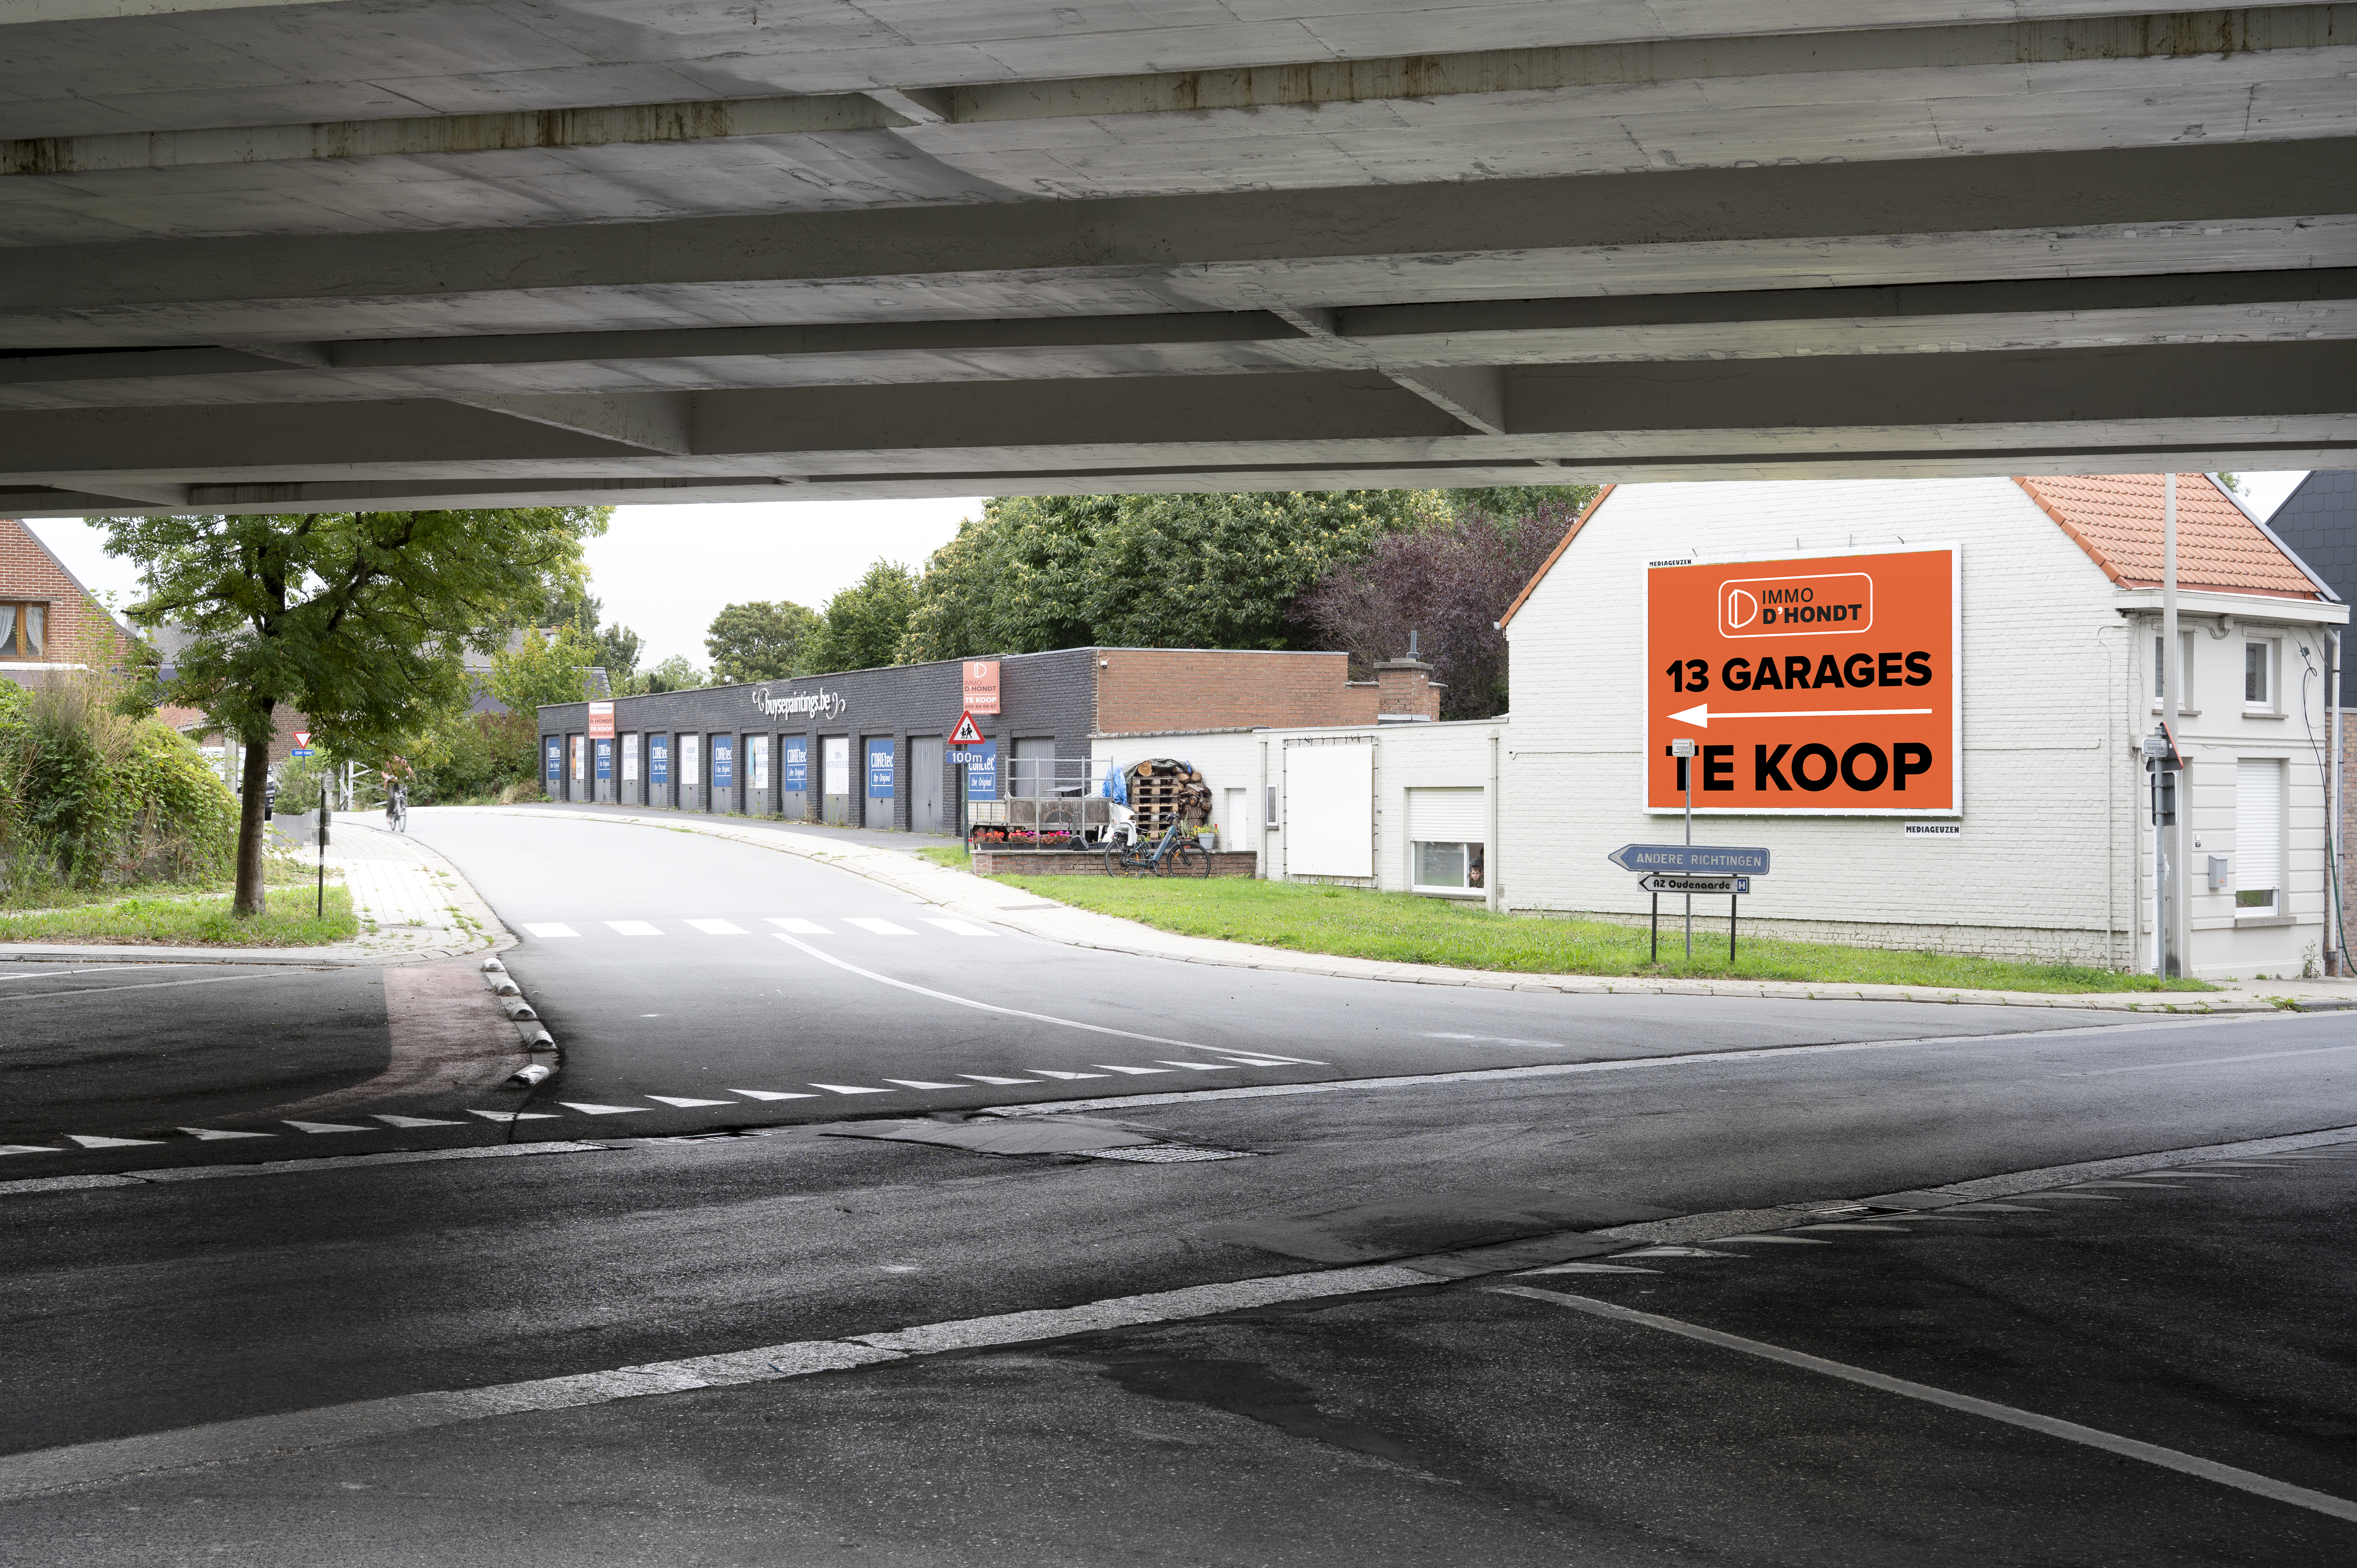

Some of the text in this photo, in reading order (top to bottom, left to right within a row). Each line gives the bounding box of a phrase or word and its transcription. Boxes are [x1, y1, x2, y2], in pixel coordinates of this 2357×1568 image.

[1762, 588, 1813, 604] IMMO
[1762, 604, 1862, 624] D'HONDT
[1666, 651, 1932, 692] 13 GARAGES
[765, 687, 830, 721] buysepaintings.be
[653, 747, 668, 759] COREtec
[715, 747, 732, 760] COREtec
[787, 749, 806, 763] COREtec
[952, 752, 982, 763] 100m
[871, 752, 893, 768] COREtec
[1666, 742, 1932, 791] TE KOOP
[722, 765, 730, 775] Original
[795, 768, 804, 778] Original
[880, 773, 891, 784] Original
[979, 776, 992, 789] Original
[1636, 853, 1761, 867] ANDERE RICHTINGEN
[1654, 879, 1665, 888] AZ
[1668, 879, 1730, 890] Oudenaarde
